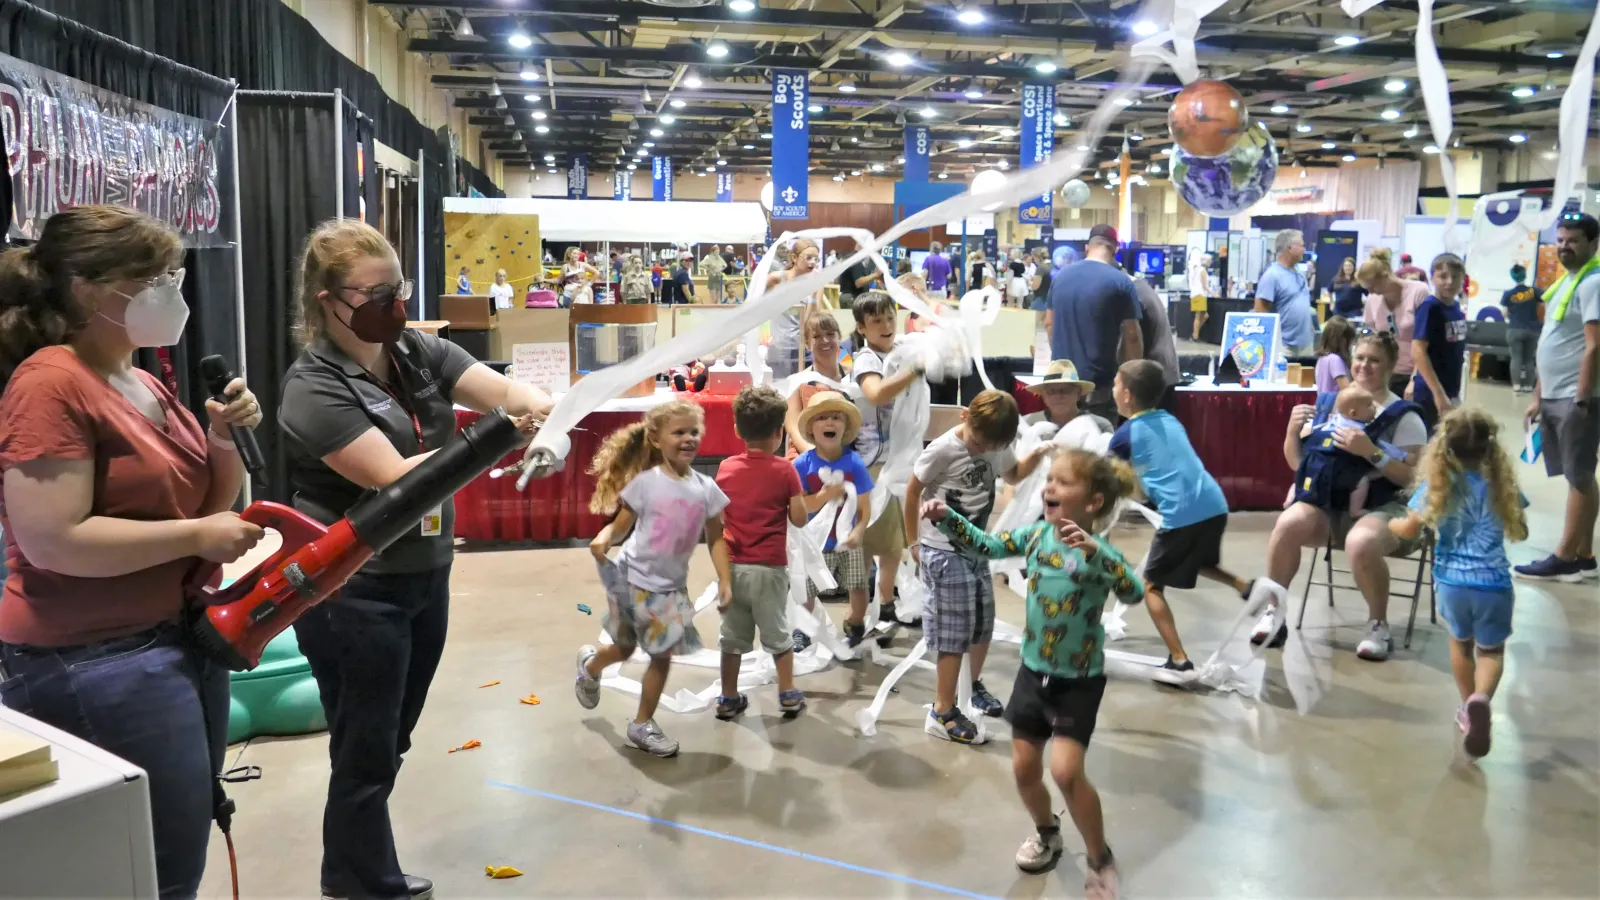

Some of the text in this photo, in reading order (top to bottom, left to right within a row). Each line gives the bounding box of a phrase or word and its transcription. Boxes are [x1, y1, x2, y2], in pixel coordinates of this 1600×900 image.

[774, 74, 791, 104] Boy
[790, 75, 804, 130] Scouts
[1024, 85, 1036, 118] COSI
[1044, 85, 1053, 109] Zone
[1034, 85, 1045, 162] Space Heartland
[1043, 110, 1053, 139] Space
[916, 127, 927, 155] COSI
[1043, 140, 1052, 148] &
[654, 156, 662, 180] Guest
[663, 156, 671, 202] nformation
[883, 248, 904, 257] OPN
